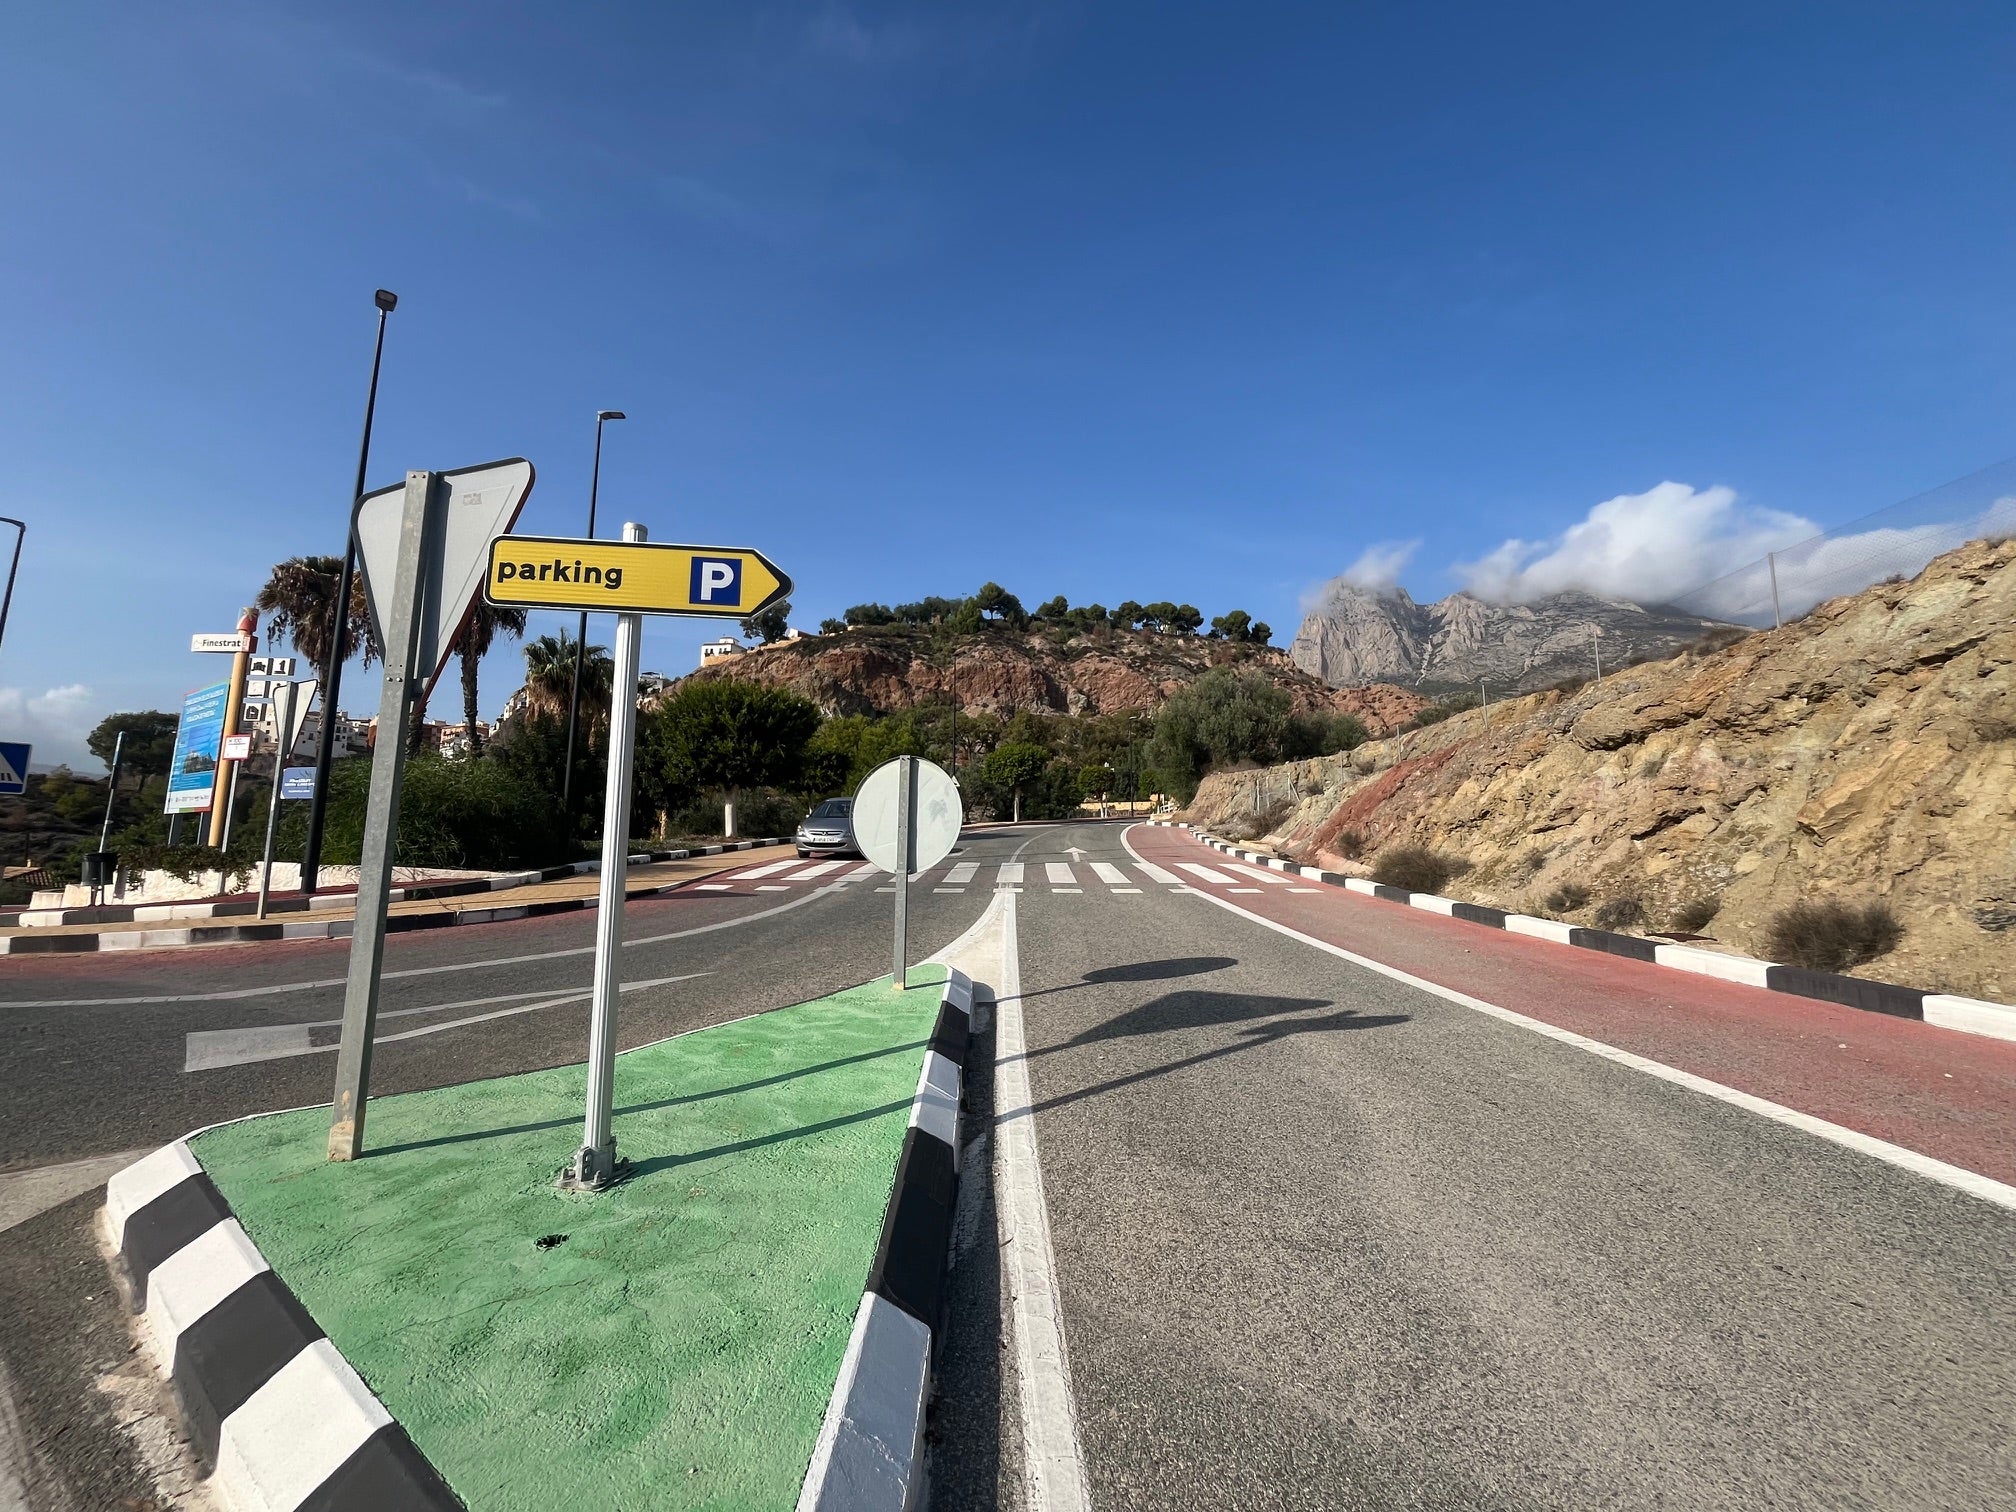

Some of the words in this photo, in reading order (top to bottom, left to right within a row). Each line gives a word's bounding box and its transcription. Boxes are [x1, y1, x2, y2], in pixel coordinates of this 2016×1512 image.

[497, 559, 623, 589] parking
[700, 561, 734, 601] P
[202, 639, 241, 647] Finestrat
